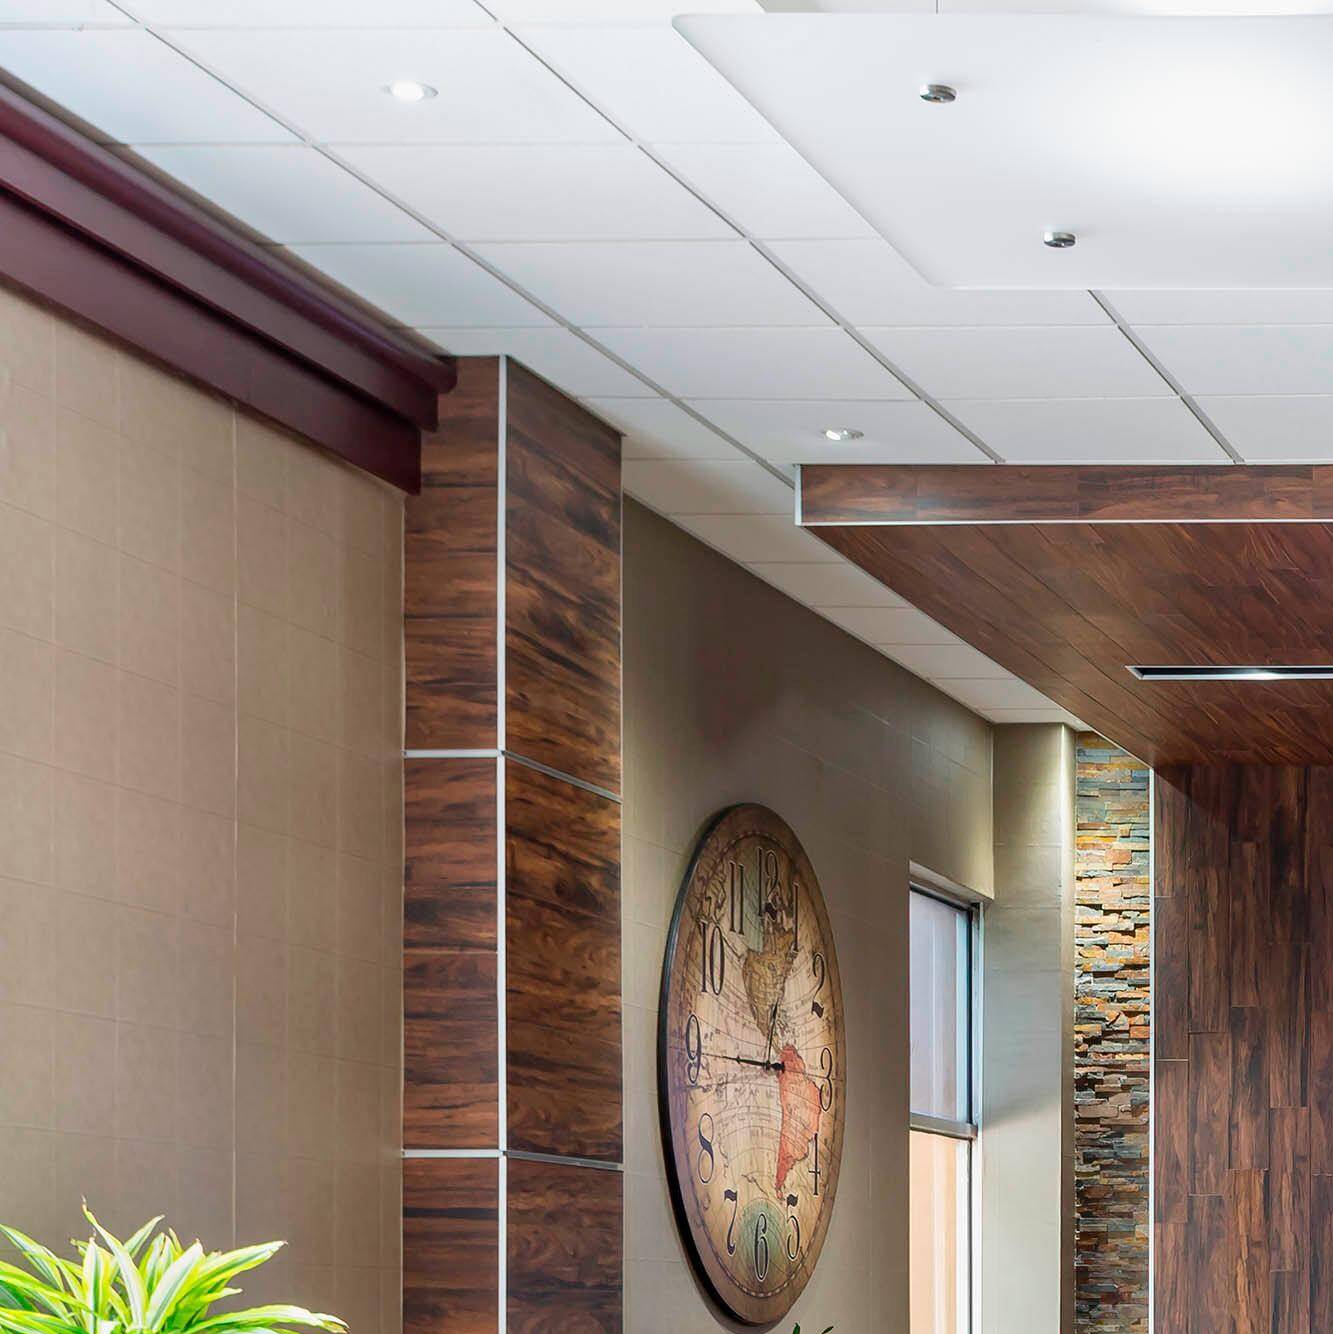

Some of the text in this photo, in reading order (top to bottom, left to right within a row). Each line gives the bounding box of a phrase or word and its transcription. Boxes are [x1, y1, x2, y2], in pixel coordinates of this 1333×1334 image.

[729, 861, 745, 935] 11
[758, 849, 779, 920] 12
[792, 882, 799, 952] 1
[700, 919, 725, 996] 10
[811, 952, 825, 1019] 2
[685, 1014, 700, 1084] 9
[820, 1047, 832, 1112] 3
[698, 1112, 714, 1184] 8
[808, 1132, 821, 1196] 4
[724, 1188, 738, 1256] 7
[754, 1212, 769, 1281] 6
[786, 1193, 800, 1260] 5
